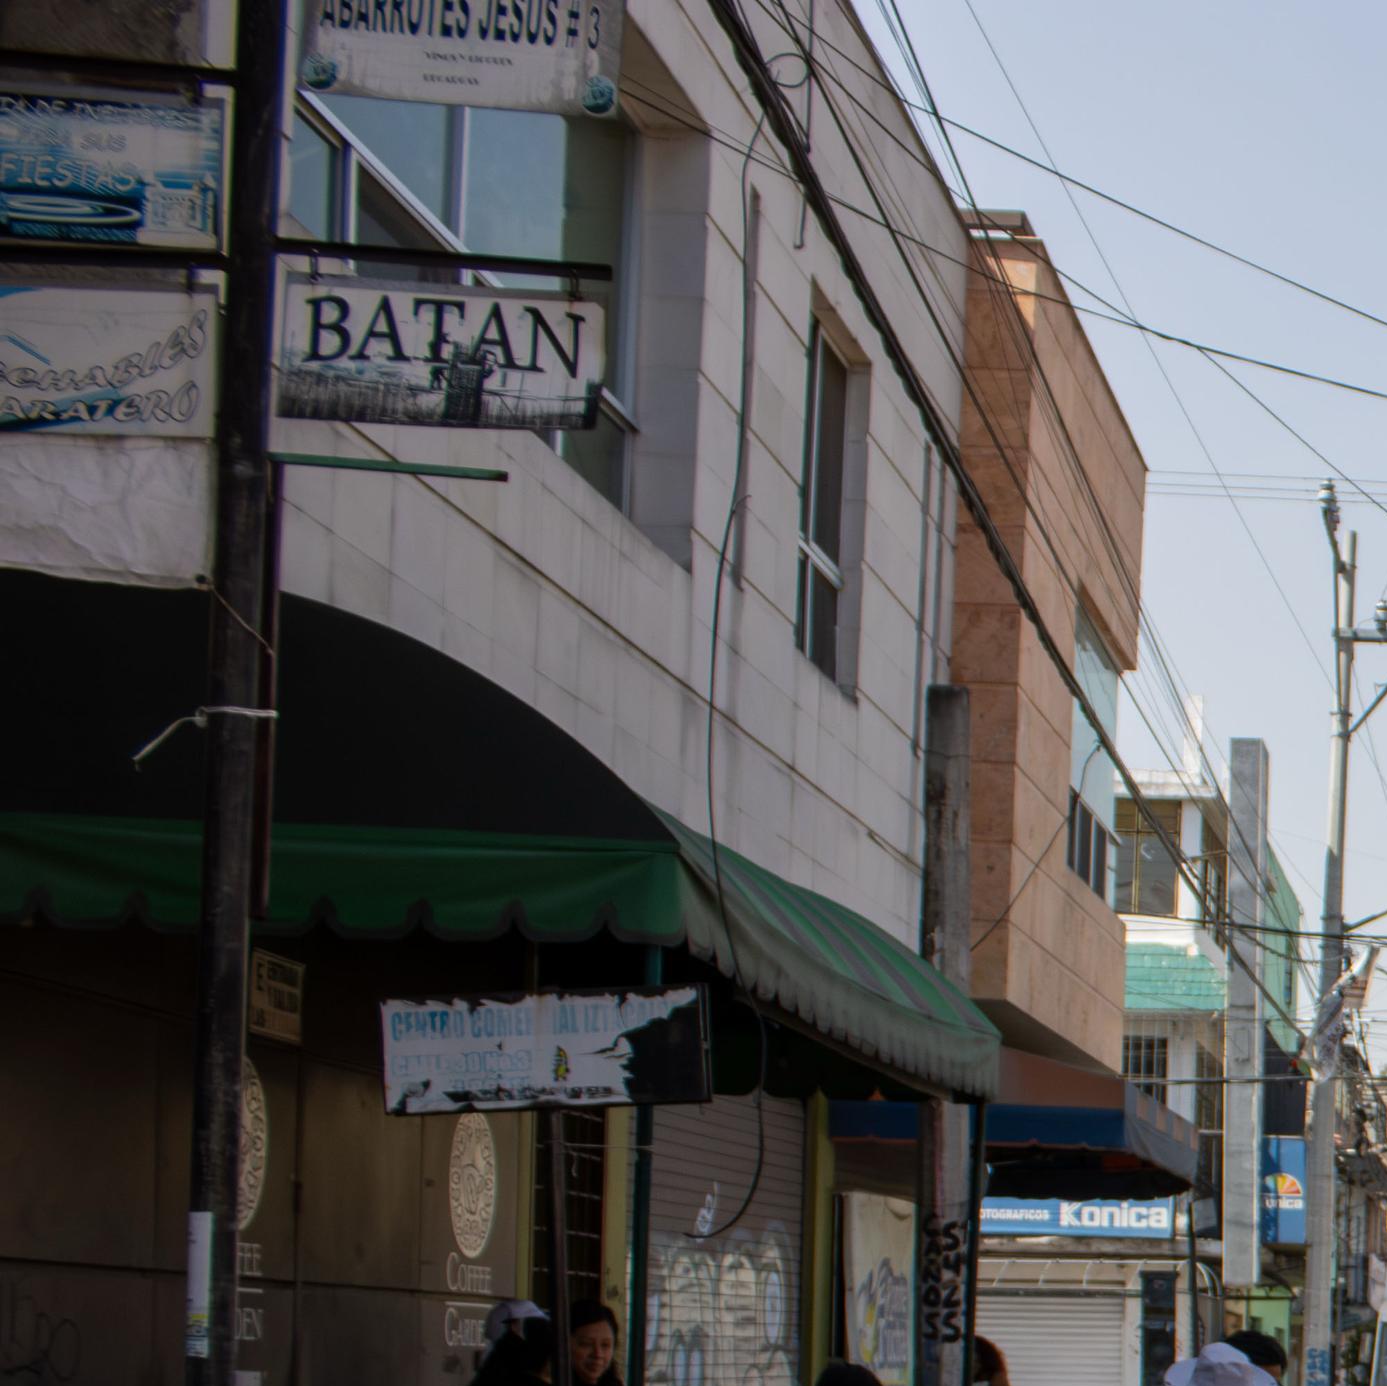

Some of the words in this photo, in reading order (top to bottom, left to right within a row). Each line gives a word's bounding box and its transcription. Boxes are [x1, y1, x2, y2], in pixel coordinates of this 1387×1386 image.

[587, 6, 600, 50] 3
[1, 151, 137, 192] FIESTAS
[302, 294, 586, 379] BATAN
[391, 1009, 465, 1041] CENTRO
[979, 1207, 1050, 1222] OTOGRAFICOS
[1058, 1201, 1170, 1229] Konica
[446, 1252, 492, 1295] COFFEE
[444, 1307, 488, 1347] GARDE
